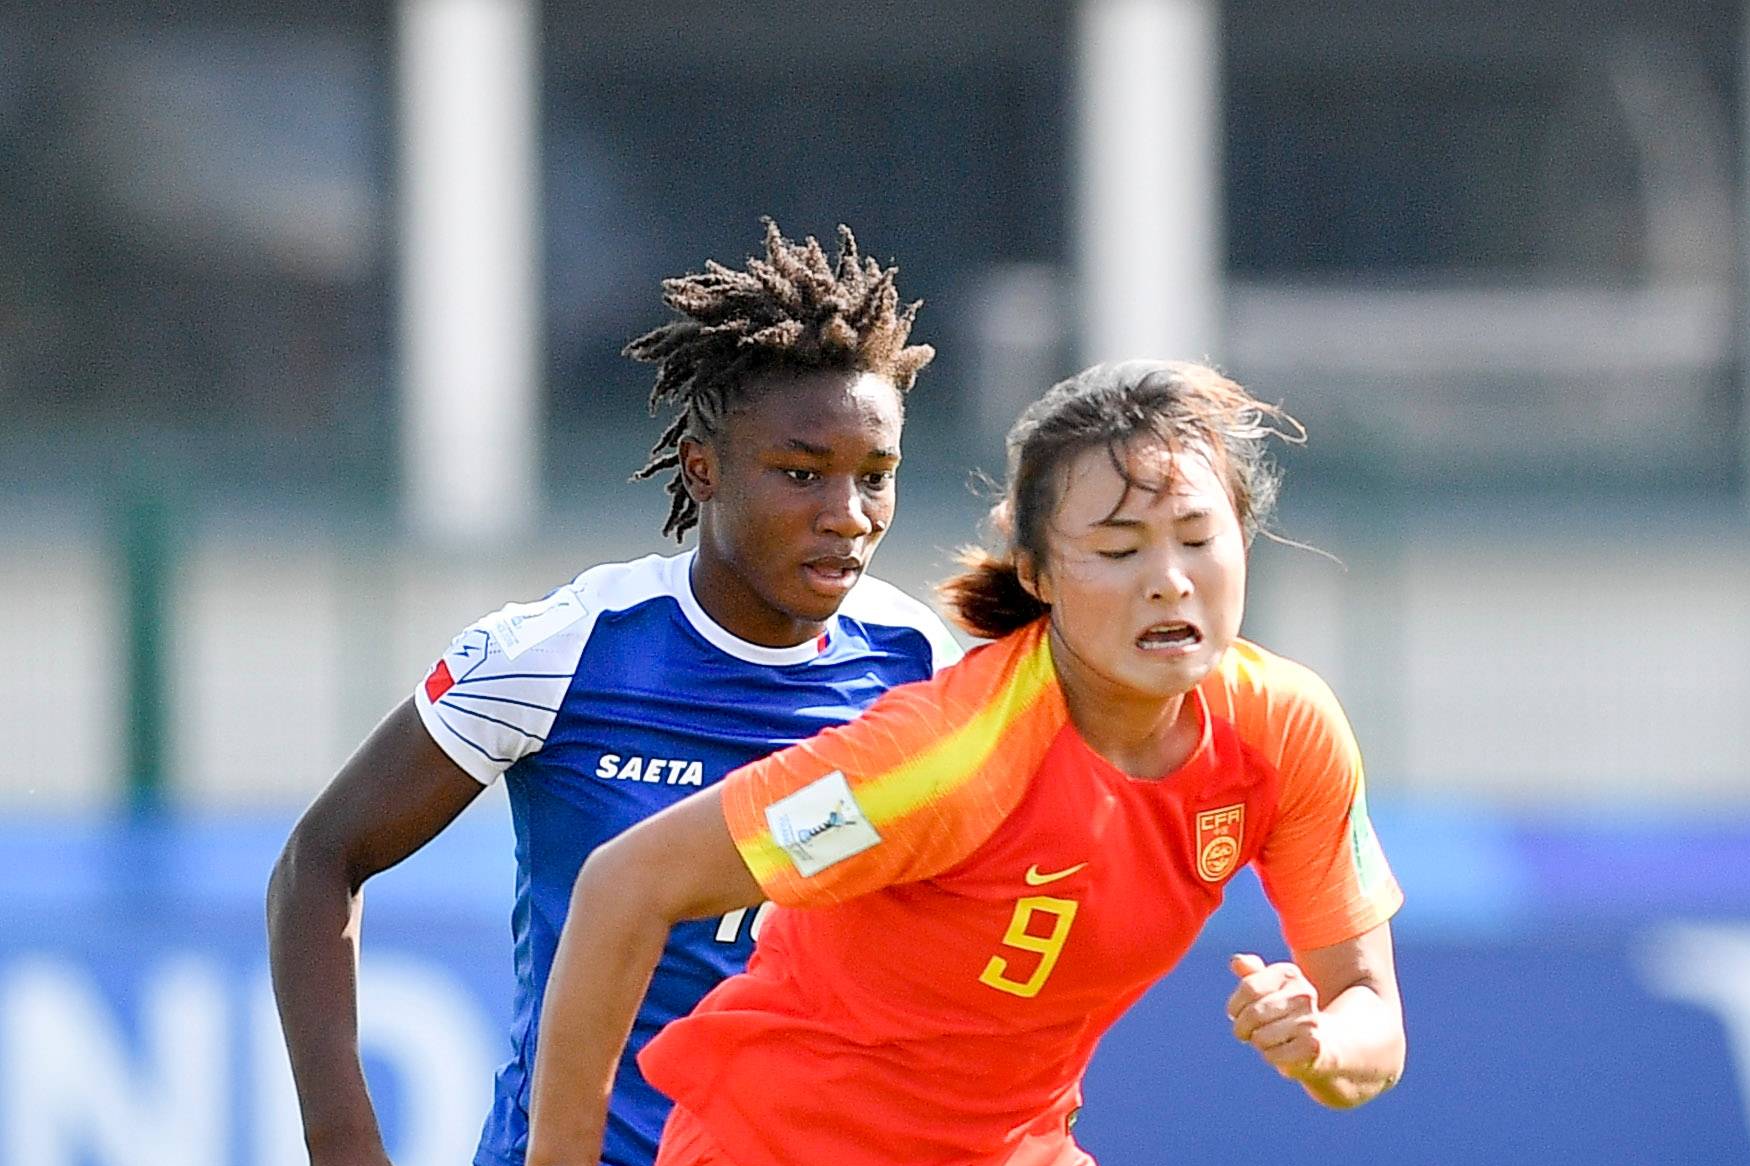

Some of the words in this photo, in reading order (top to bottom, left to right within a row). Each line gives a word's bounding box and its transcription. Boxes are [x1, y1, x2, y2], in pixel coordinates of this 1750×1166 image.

[595, 754, 703, 786] SAETA
[1201, 809, 1241, 831] CFA
[978, 895, 1080, 998] 9
